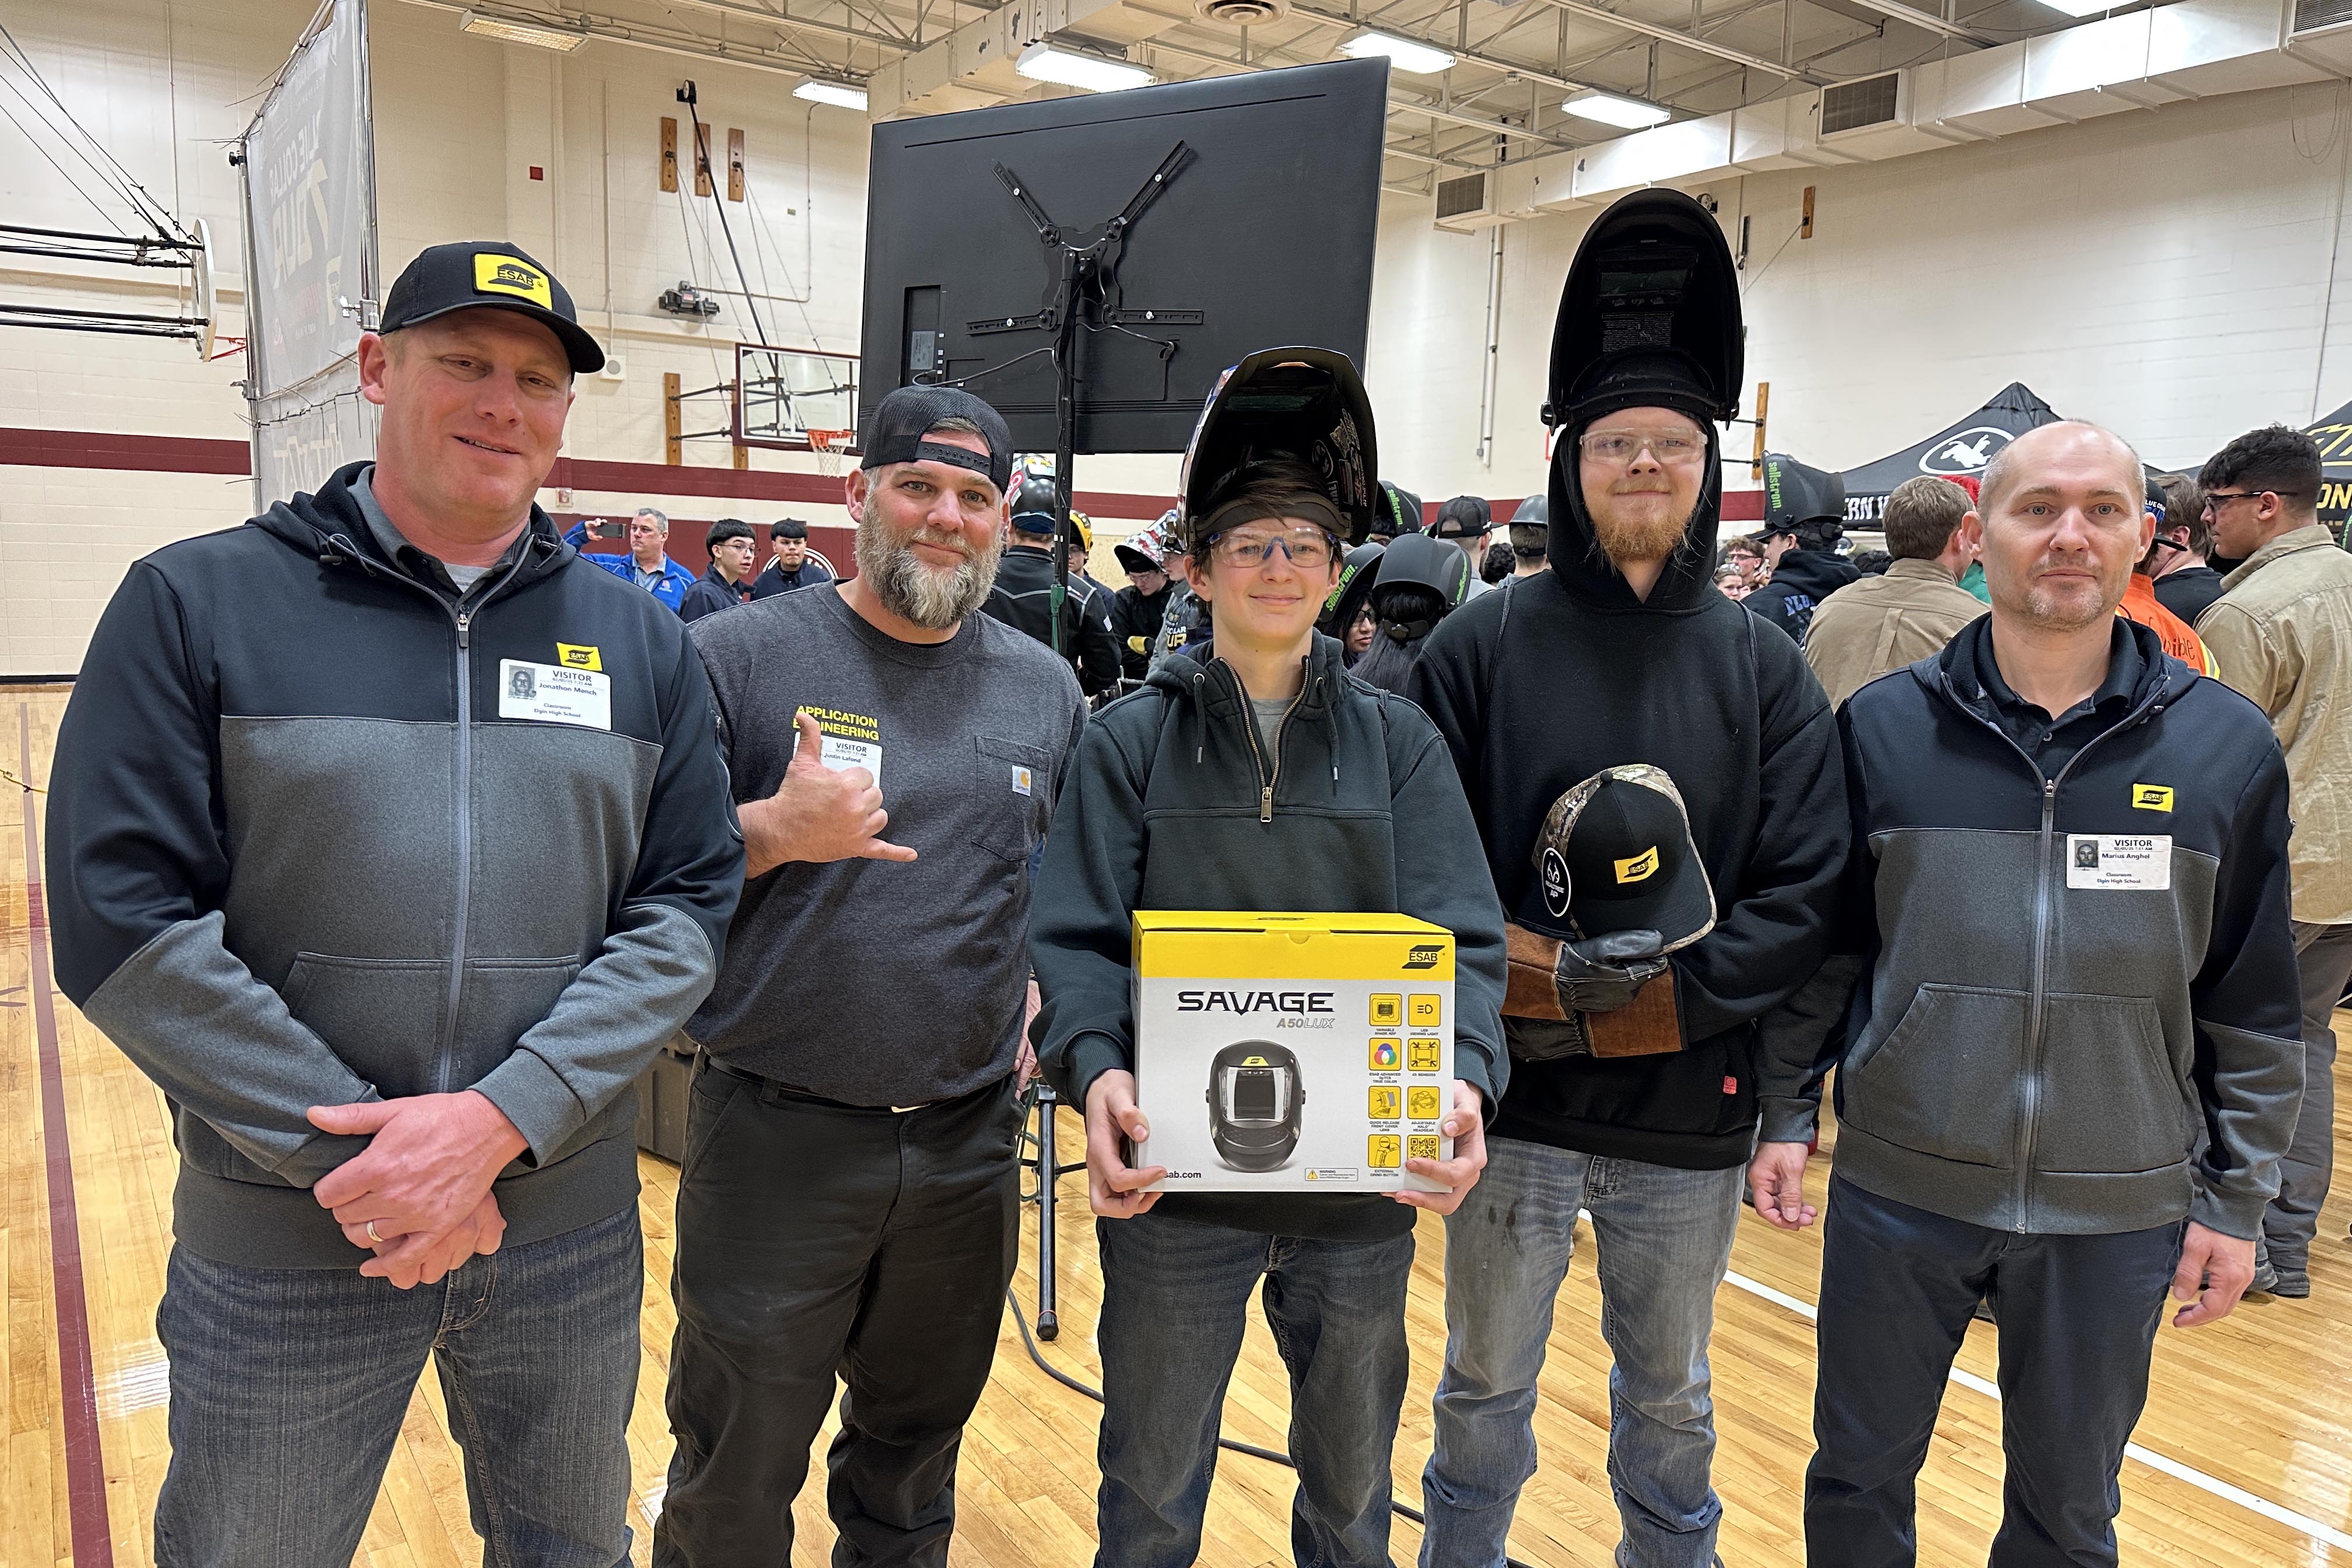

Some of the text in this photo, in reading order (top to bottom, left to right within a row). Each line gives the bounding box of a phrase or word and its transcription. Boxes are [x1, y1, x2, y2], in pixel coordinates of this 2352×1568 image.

[498, 269, 534, 286] ESAB
[569, 652, 590, 661] ESAB
[552, 670, 592, 682] VISITOR
[539, 682, 572, 692] Jonathon
[796, 705, 878, 729] APPLICATION
[793, 718, 880, 741] EINEERING
[836, 742, 867, 753] VISITOR
[2143, 793, 2164, 802] ESAB
[1628, 861, 1649, 873] ESAB
[1409, 952, 1438, 961] ESAB
[1177, 991, 1335, 1016] SAVAGE
